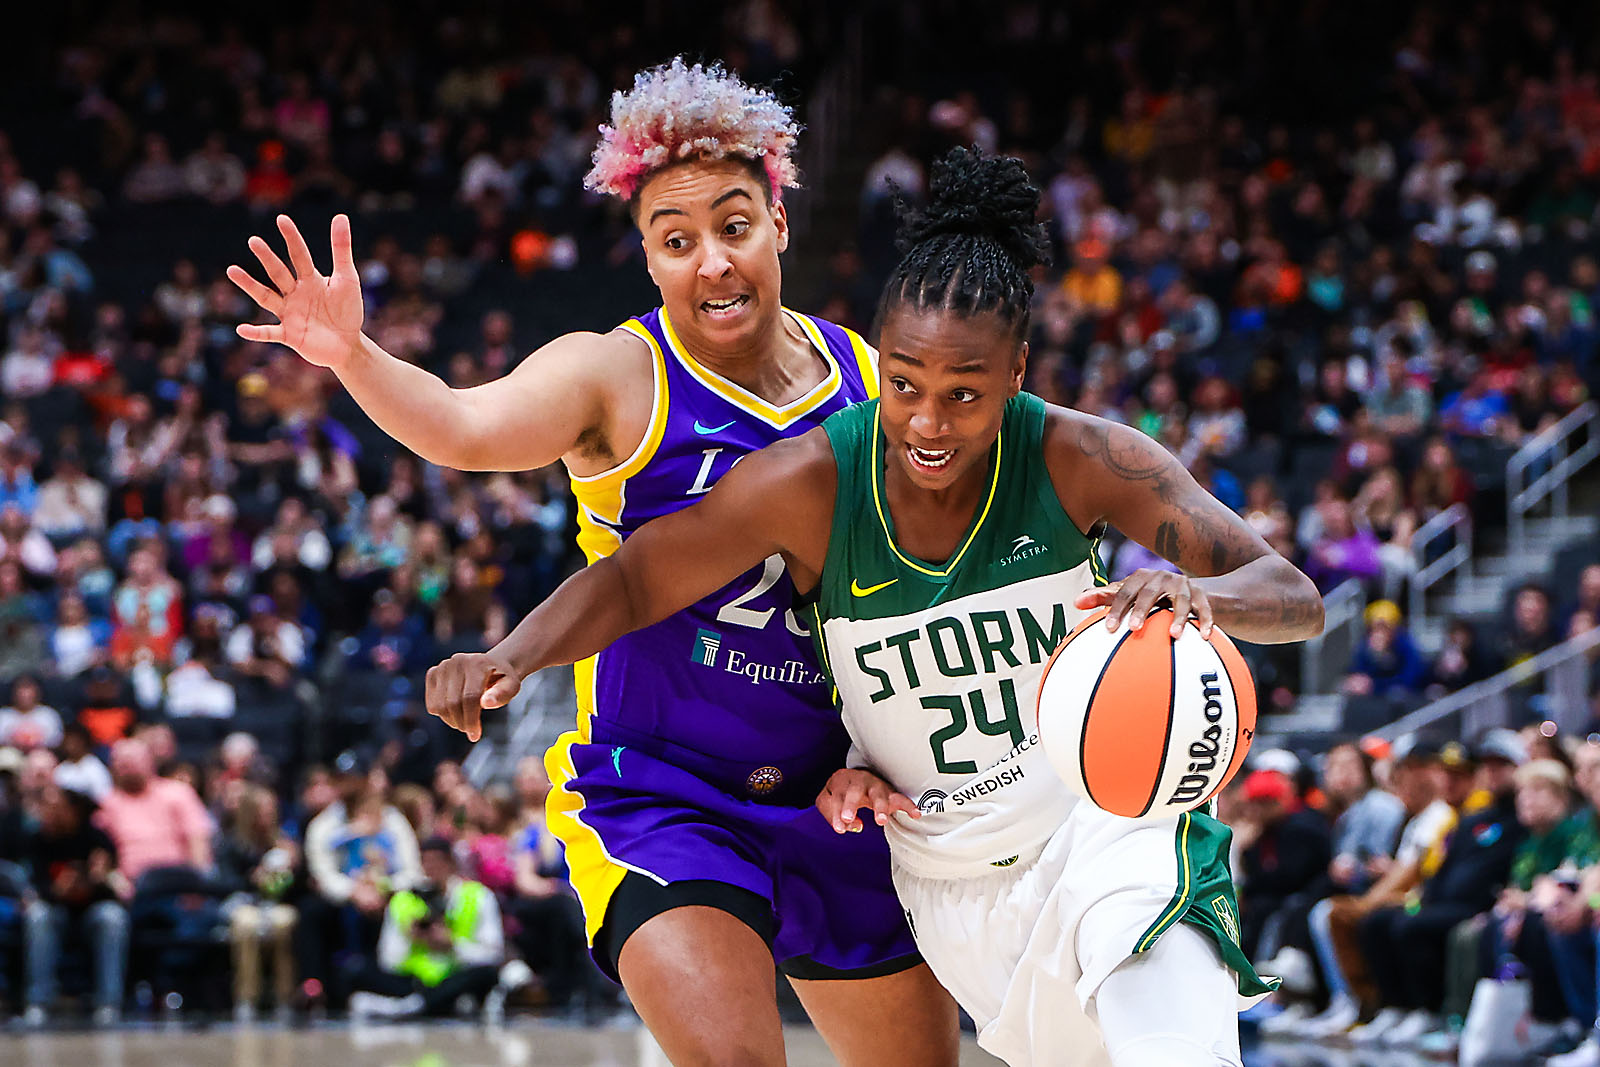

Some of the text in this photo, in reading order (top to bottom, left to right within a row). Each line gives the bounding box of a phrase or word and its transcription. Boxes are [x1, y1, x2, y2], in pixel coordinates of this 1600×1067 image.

[685, 447, 745, 495] L
[1000, 544, 1048, 567] SYMETRA
[724, 649, 826, 684] EquiTr
[855, 603, 1067, 704] STORM
[919, 678, 1025, 774] 24
[1165, 671, 1222, 806] Wilson
[952, 765, 1025, 806] SWEDISH
